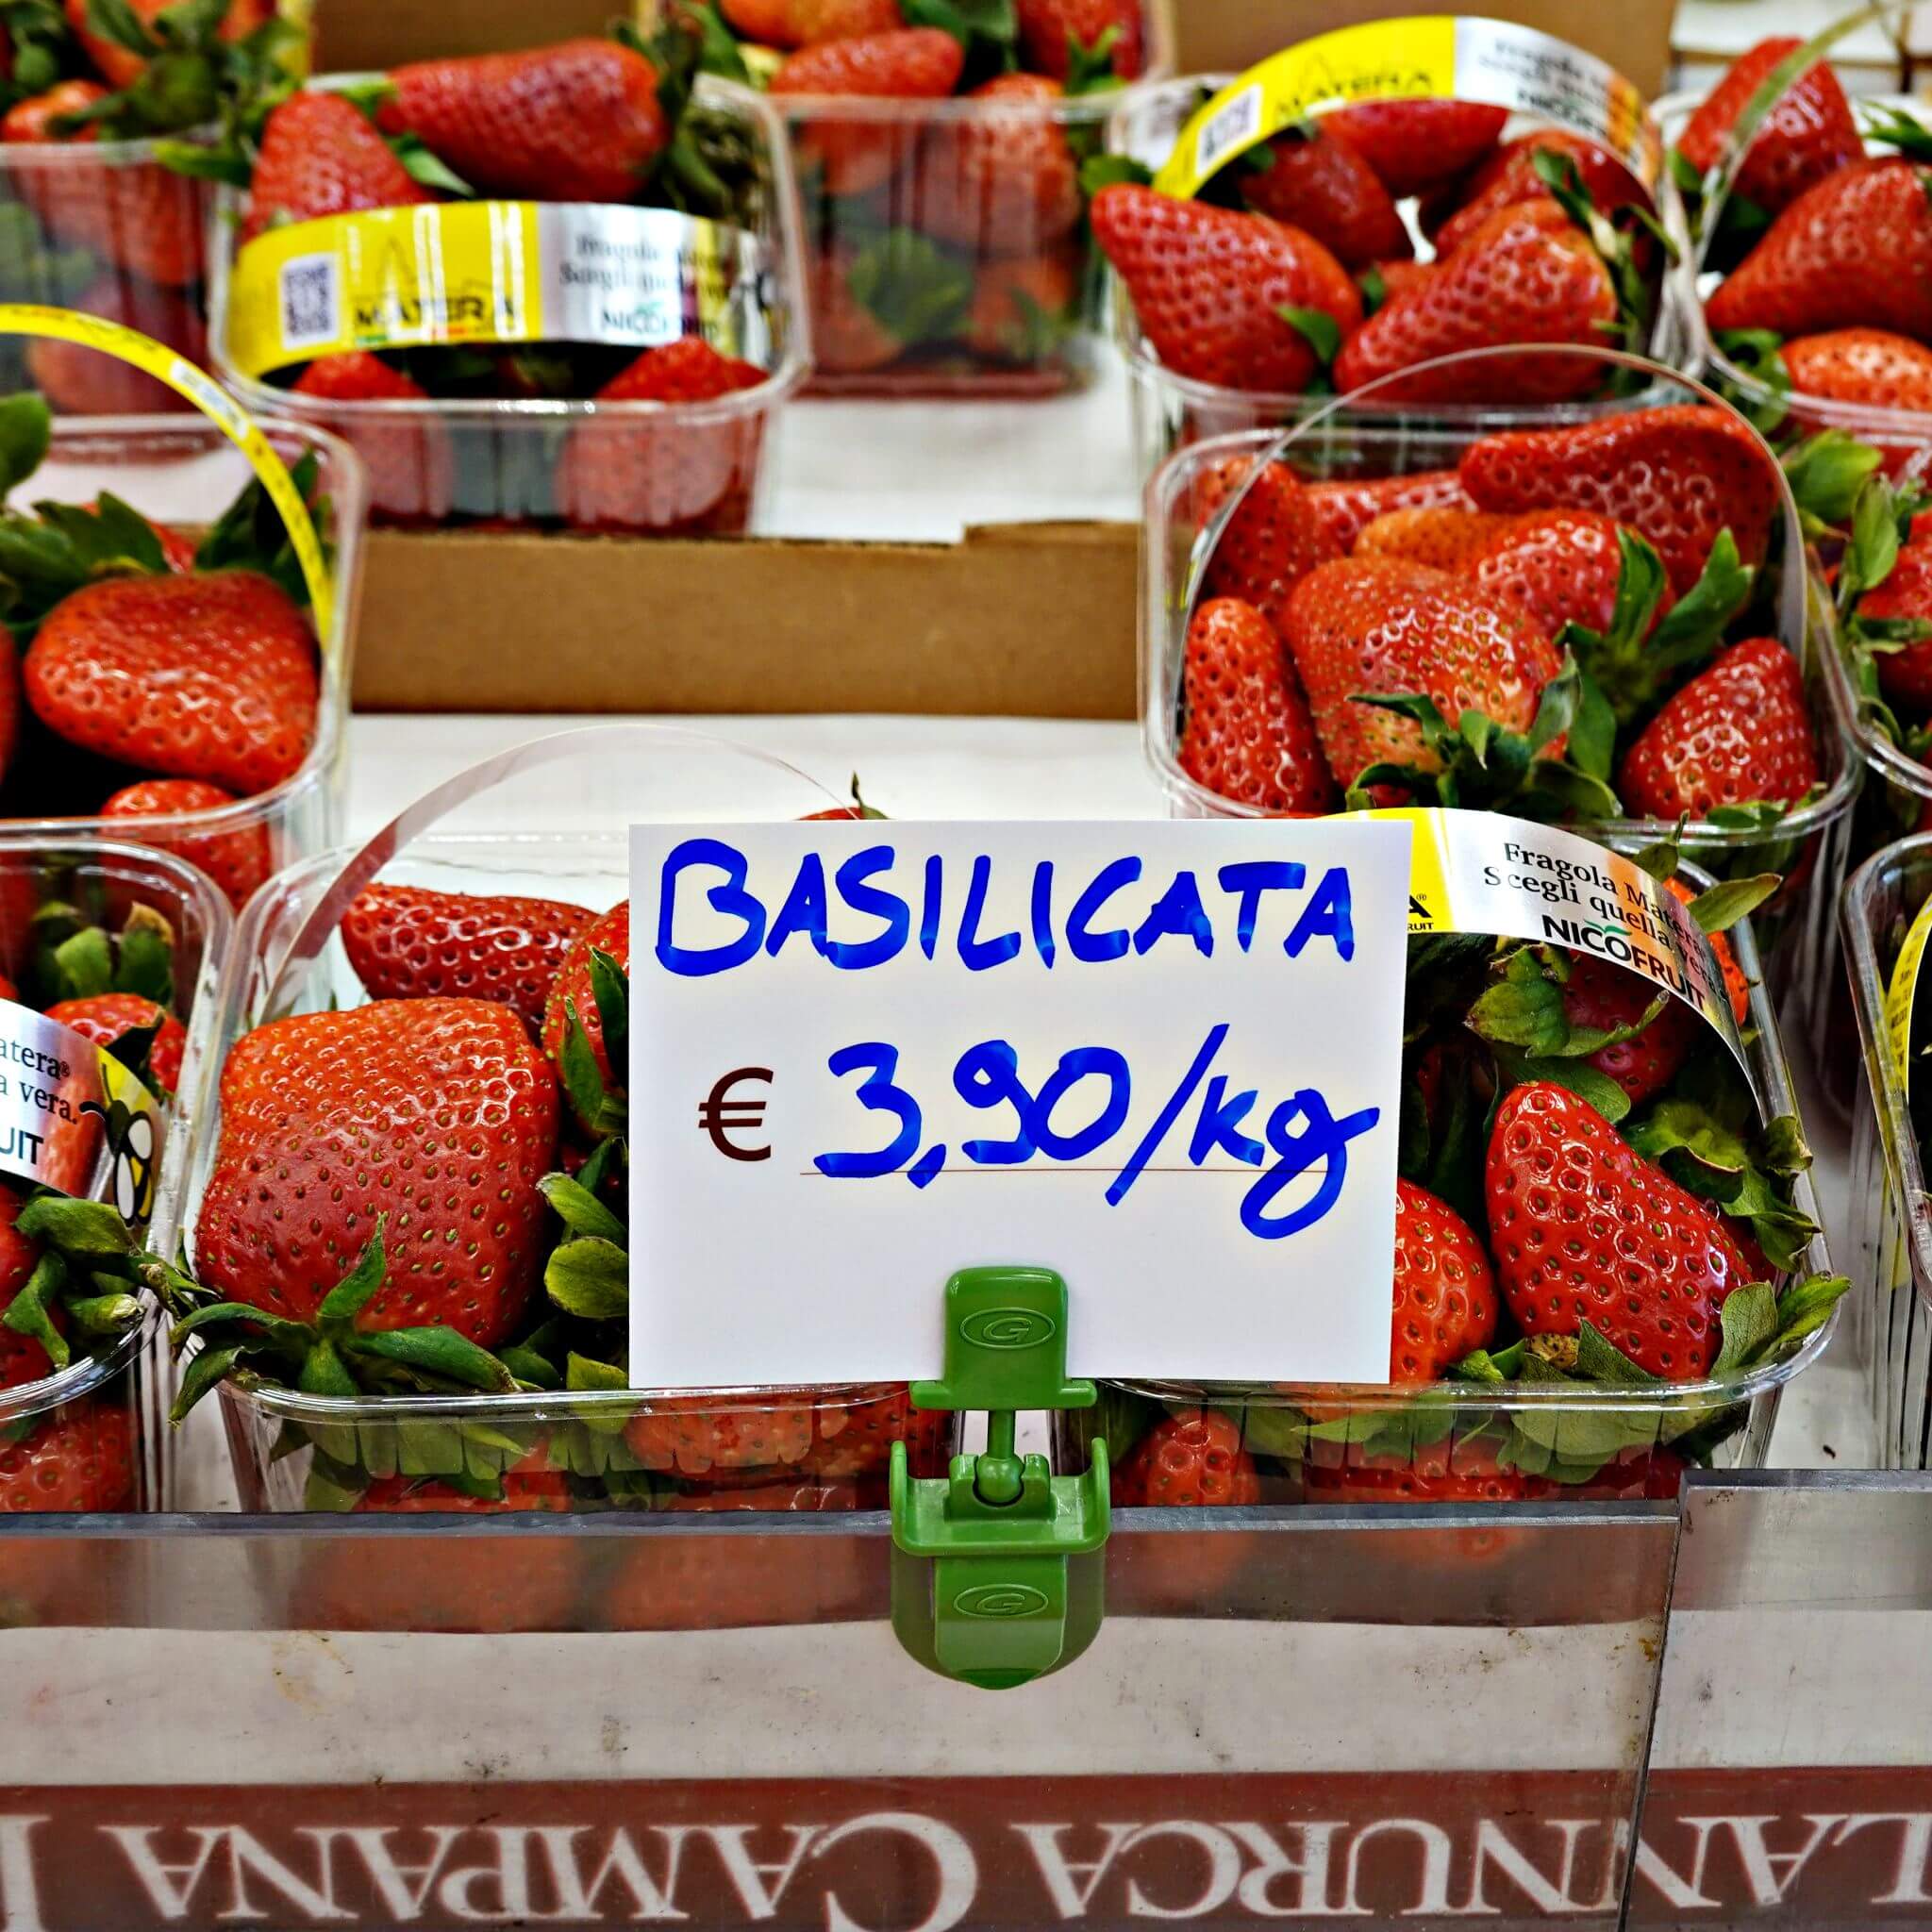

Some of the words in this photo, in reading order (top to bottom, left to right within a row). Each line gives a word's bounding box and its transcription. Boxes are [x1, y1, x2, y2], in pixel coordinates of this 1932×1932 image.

[655, 838, 1355, 977] BASILICATA
[1483, 866, 1582, 906] Scegli
[1590, 895, 1673, 952] quella
[1503, 841, 1620, 896] Fragola
[1541, 913, 1706, 1012] NICOFRUIT
[19, 1081, 77, 1124] vera.
[96, 1811, 977, 1932] CAMPANA
